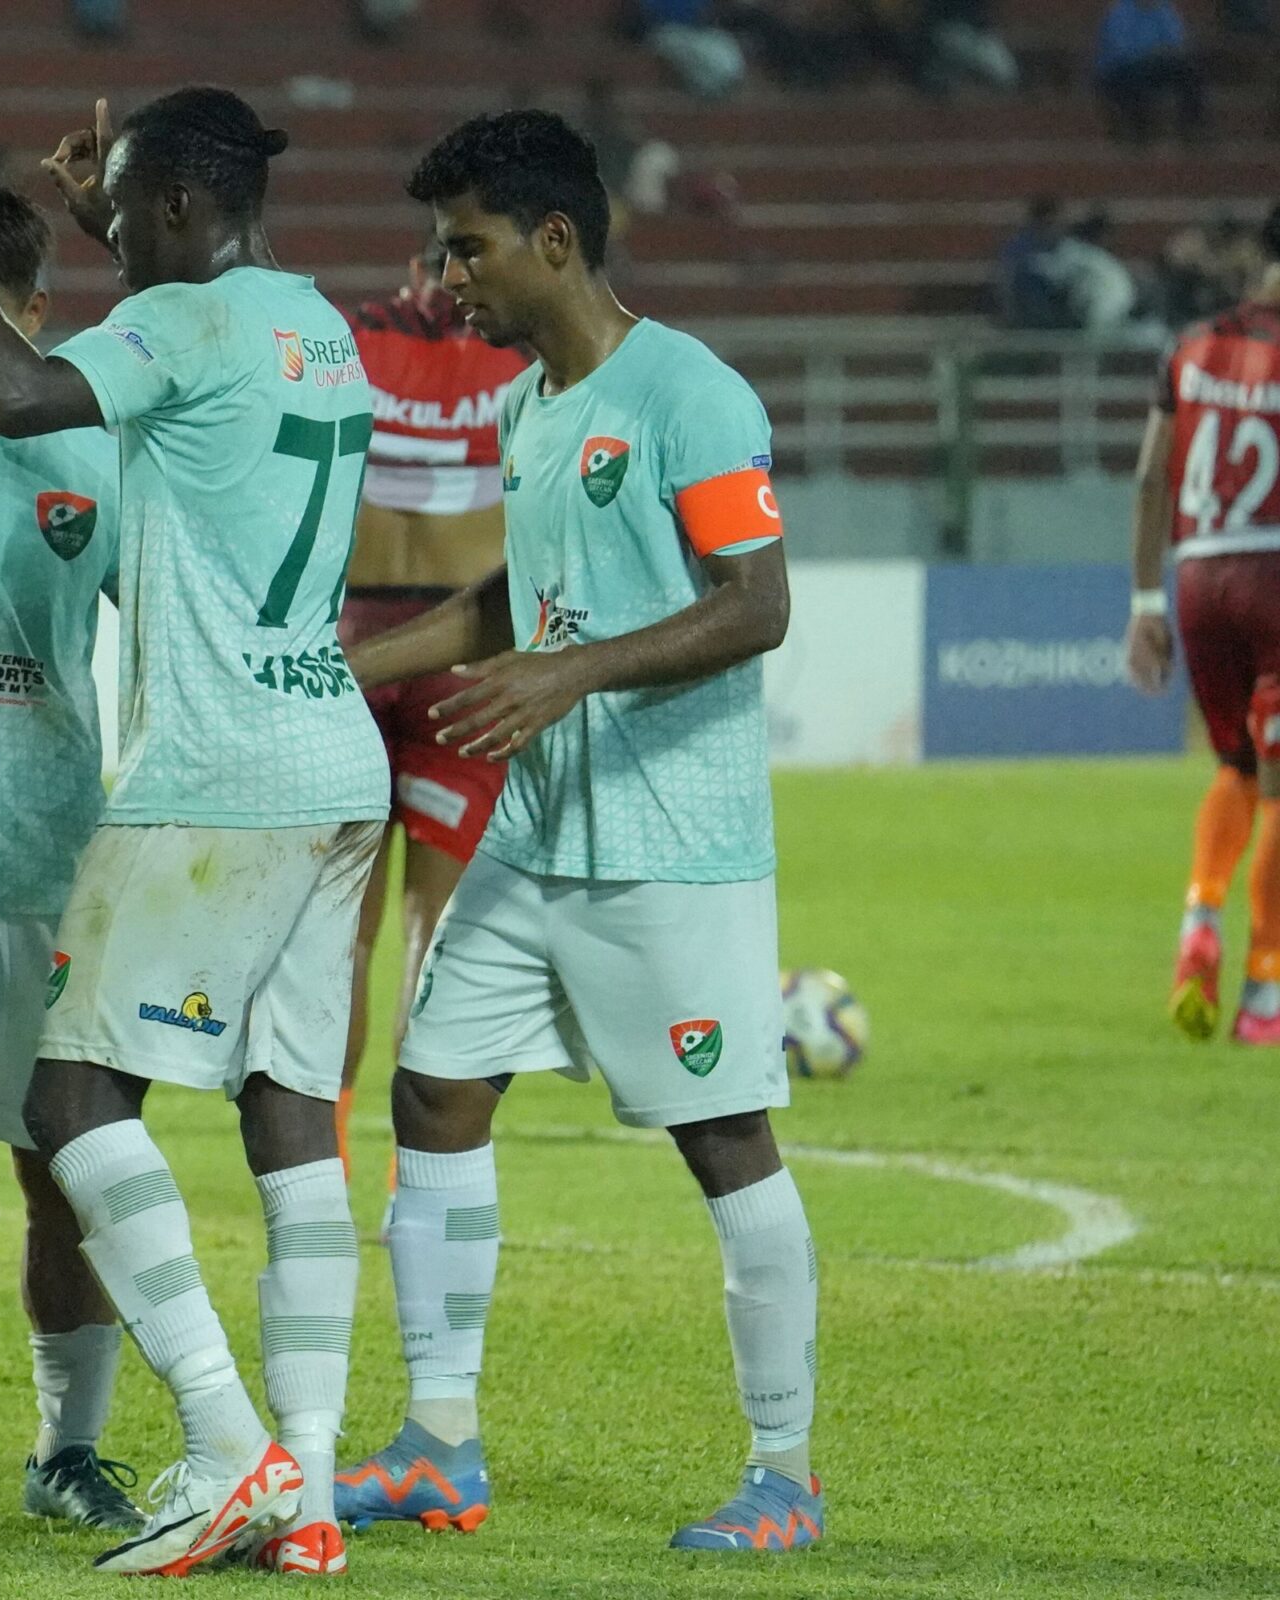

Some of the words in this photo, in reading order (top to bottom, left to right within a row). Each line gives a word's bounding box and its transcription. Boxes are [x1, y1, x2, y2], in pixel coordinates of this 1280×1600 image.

[256, 412, 373, 628] 77
[1179, 409, 1280, 534] 42
[938, 637, 1130, 690] KOZHIKO
